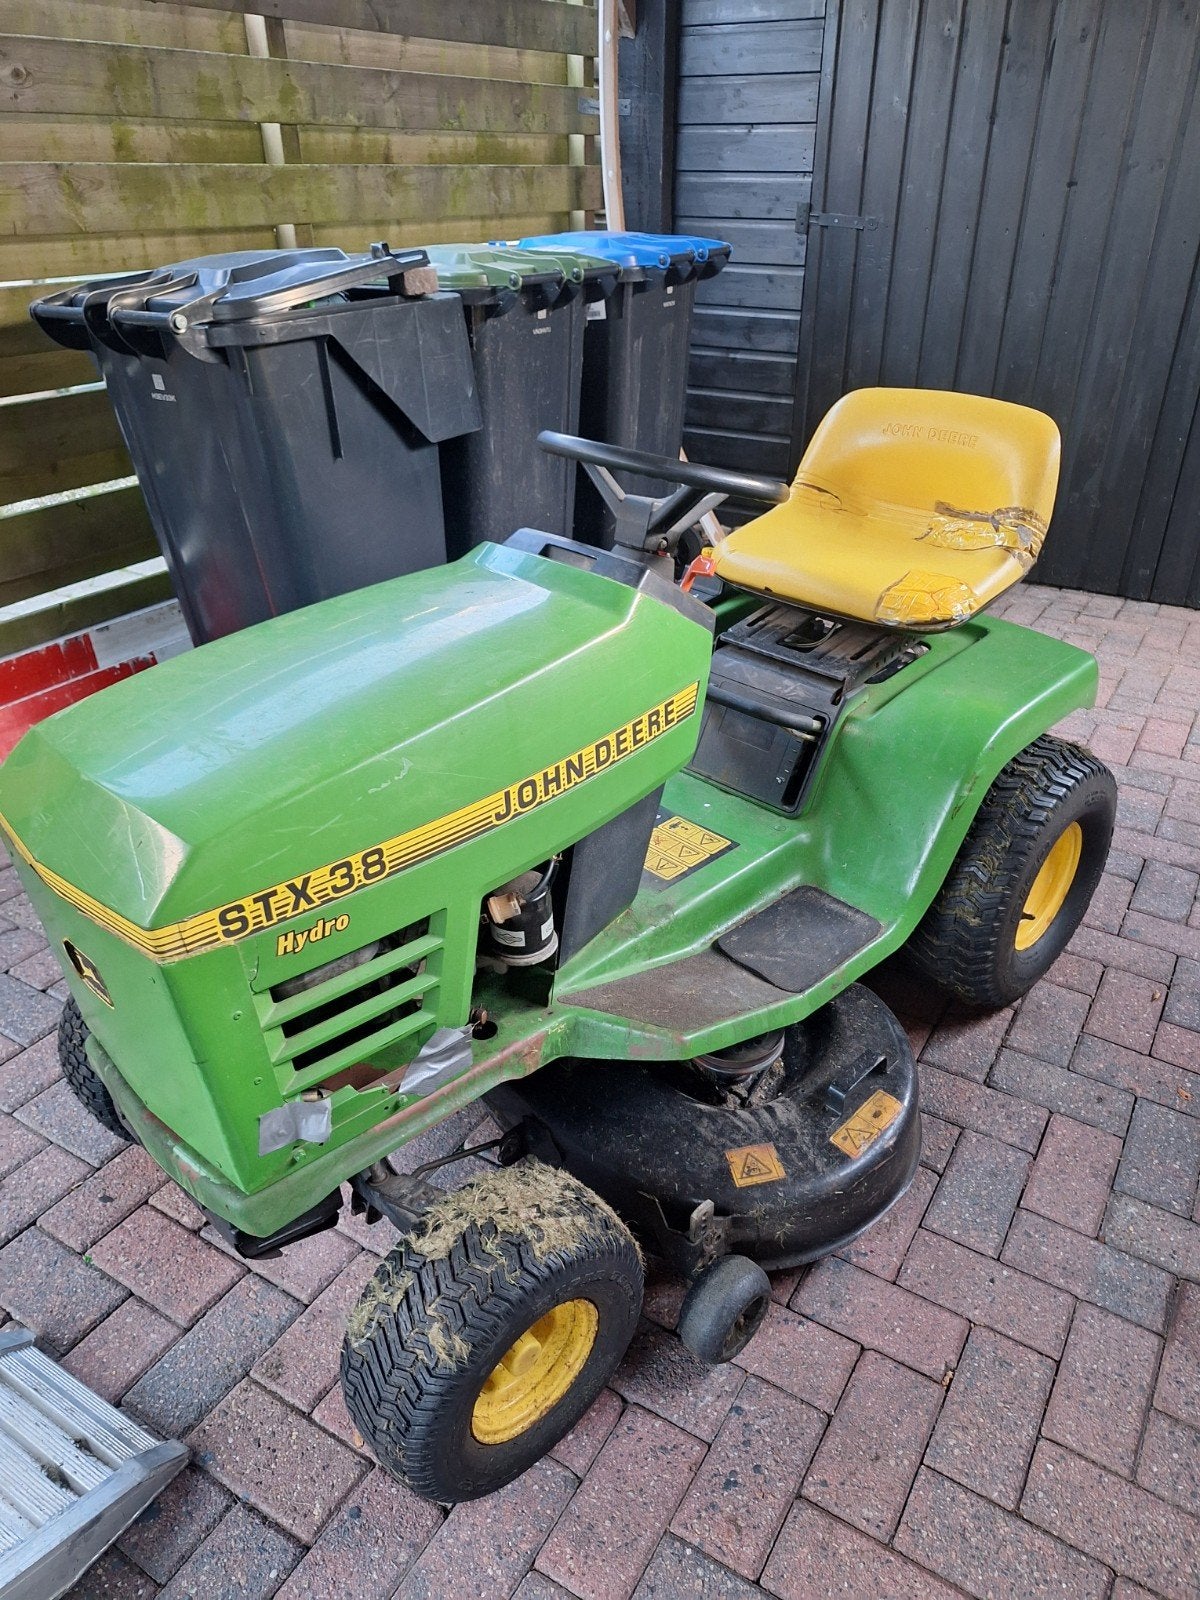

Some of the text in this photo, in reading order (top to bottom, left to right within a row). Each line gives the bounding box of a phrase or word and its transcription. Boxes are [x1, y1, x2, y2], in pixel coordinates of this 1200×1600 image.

[883, 422, 978, 449] JOHN DEERE
[494, 700, 675, 822] JOHN DEERE
[218, 847, 387, 939] STX 38
[276, 913, 351, 957] Hydro
